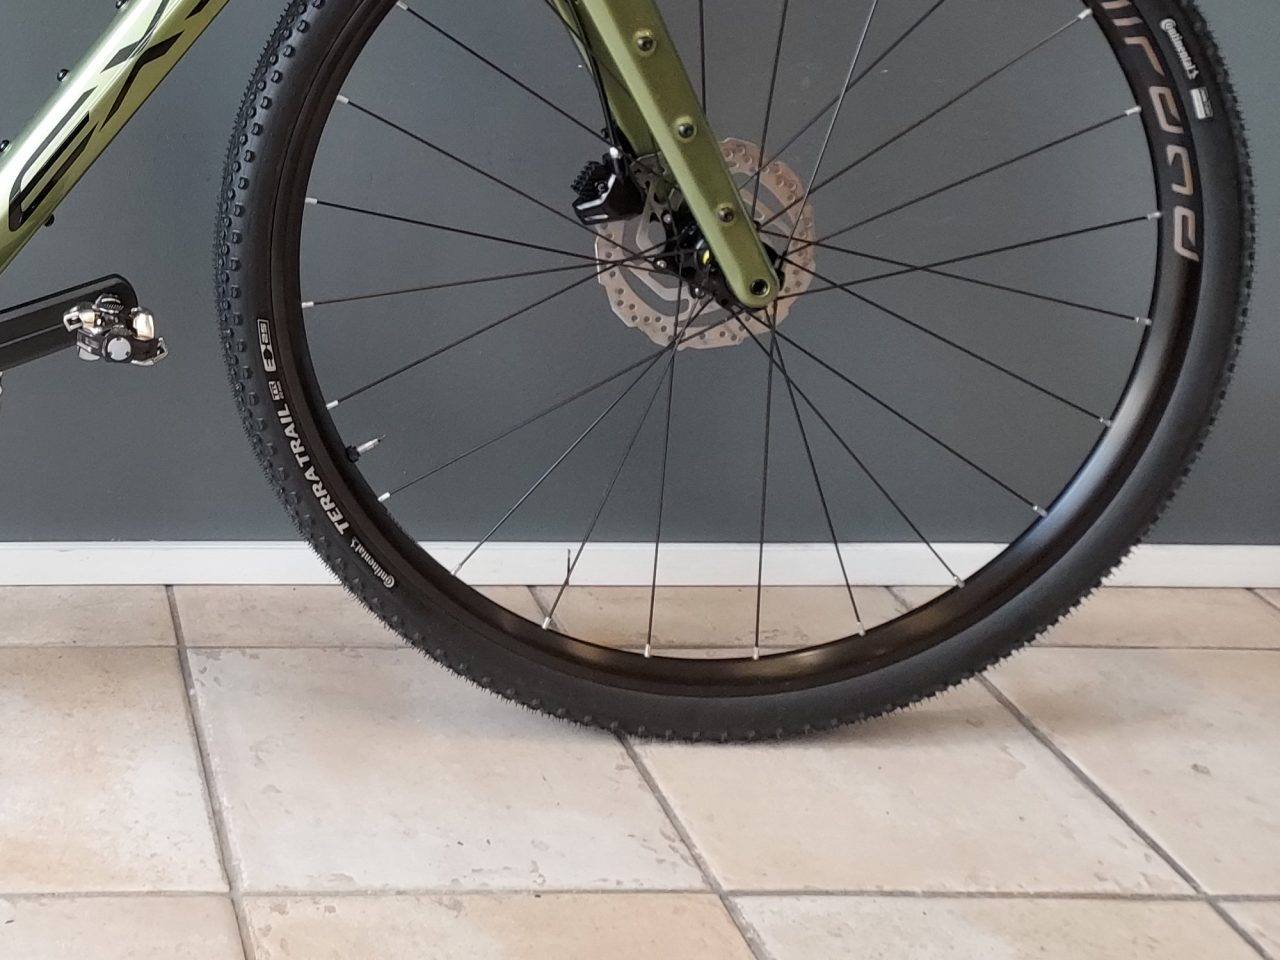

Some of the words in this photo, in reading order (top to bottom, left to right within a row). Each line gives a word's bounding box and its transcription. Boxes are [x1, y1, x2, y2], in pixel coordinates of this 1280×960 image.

[277, 401, 313, 469] TRAIL
[304, 466, 351, 536] TERRA
[354, 540, 396, 589] Continental
